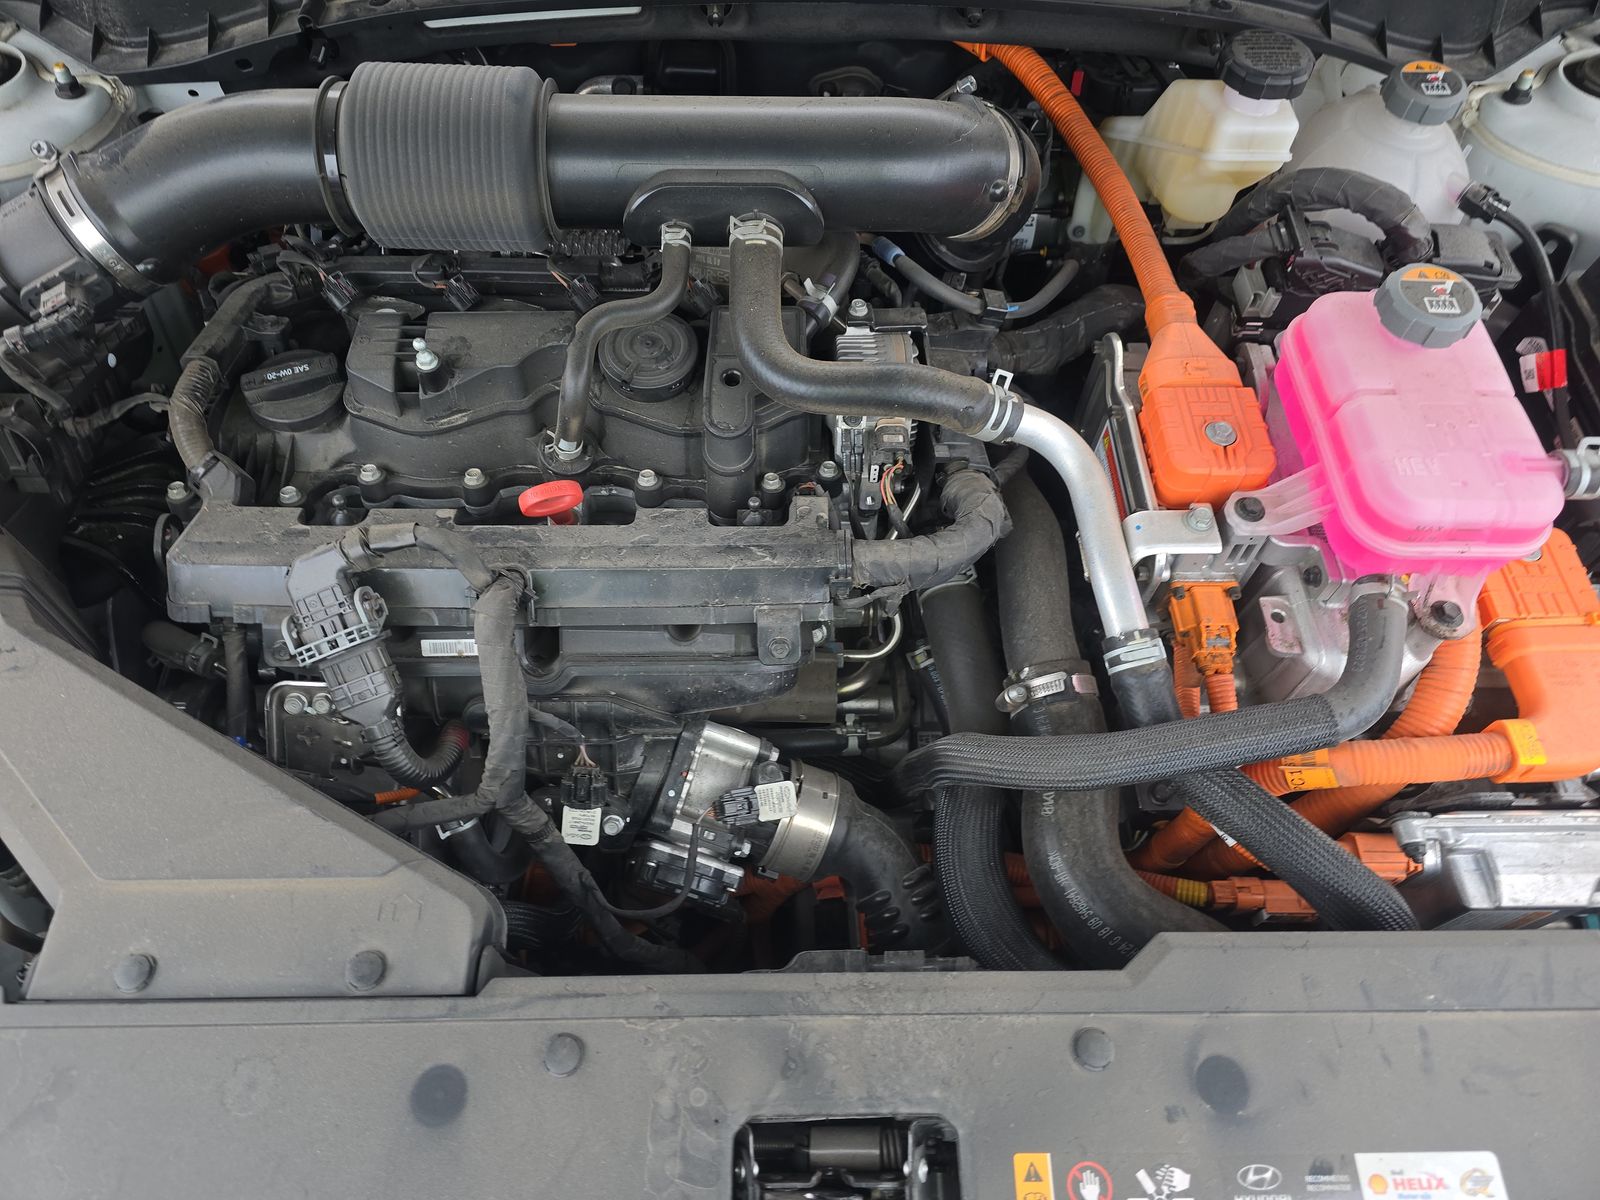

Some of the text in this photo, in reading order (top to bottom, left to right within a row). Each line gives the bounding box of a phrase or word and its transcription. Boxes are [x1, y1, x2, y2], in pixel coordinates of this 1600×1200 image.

[266, 363, 310, 381] SAE 0W-20
[1097, 926, 1115, 940] 18
[1392, 1177, 1450, 1192] HELIX
